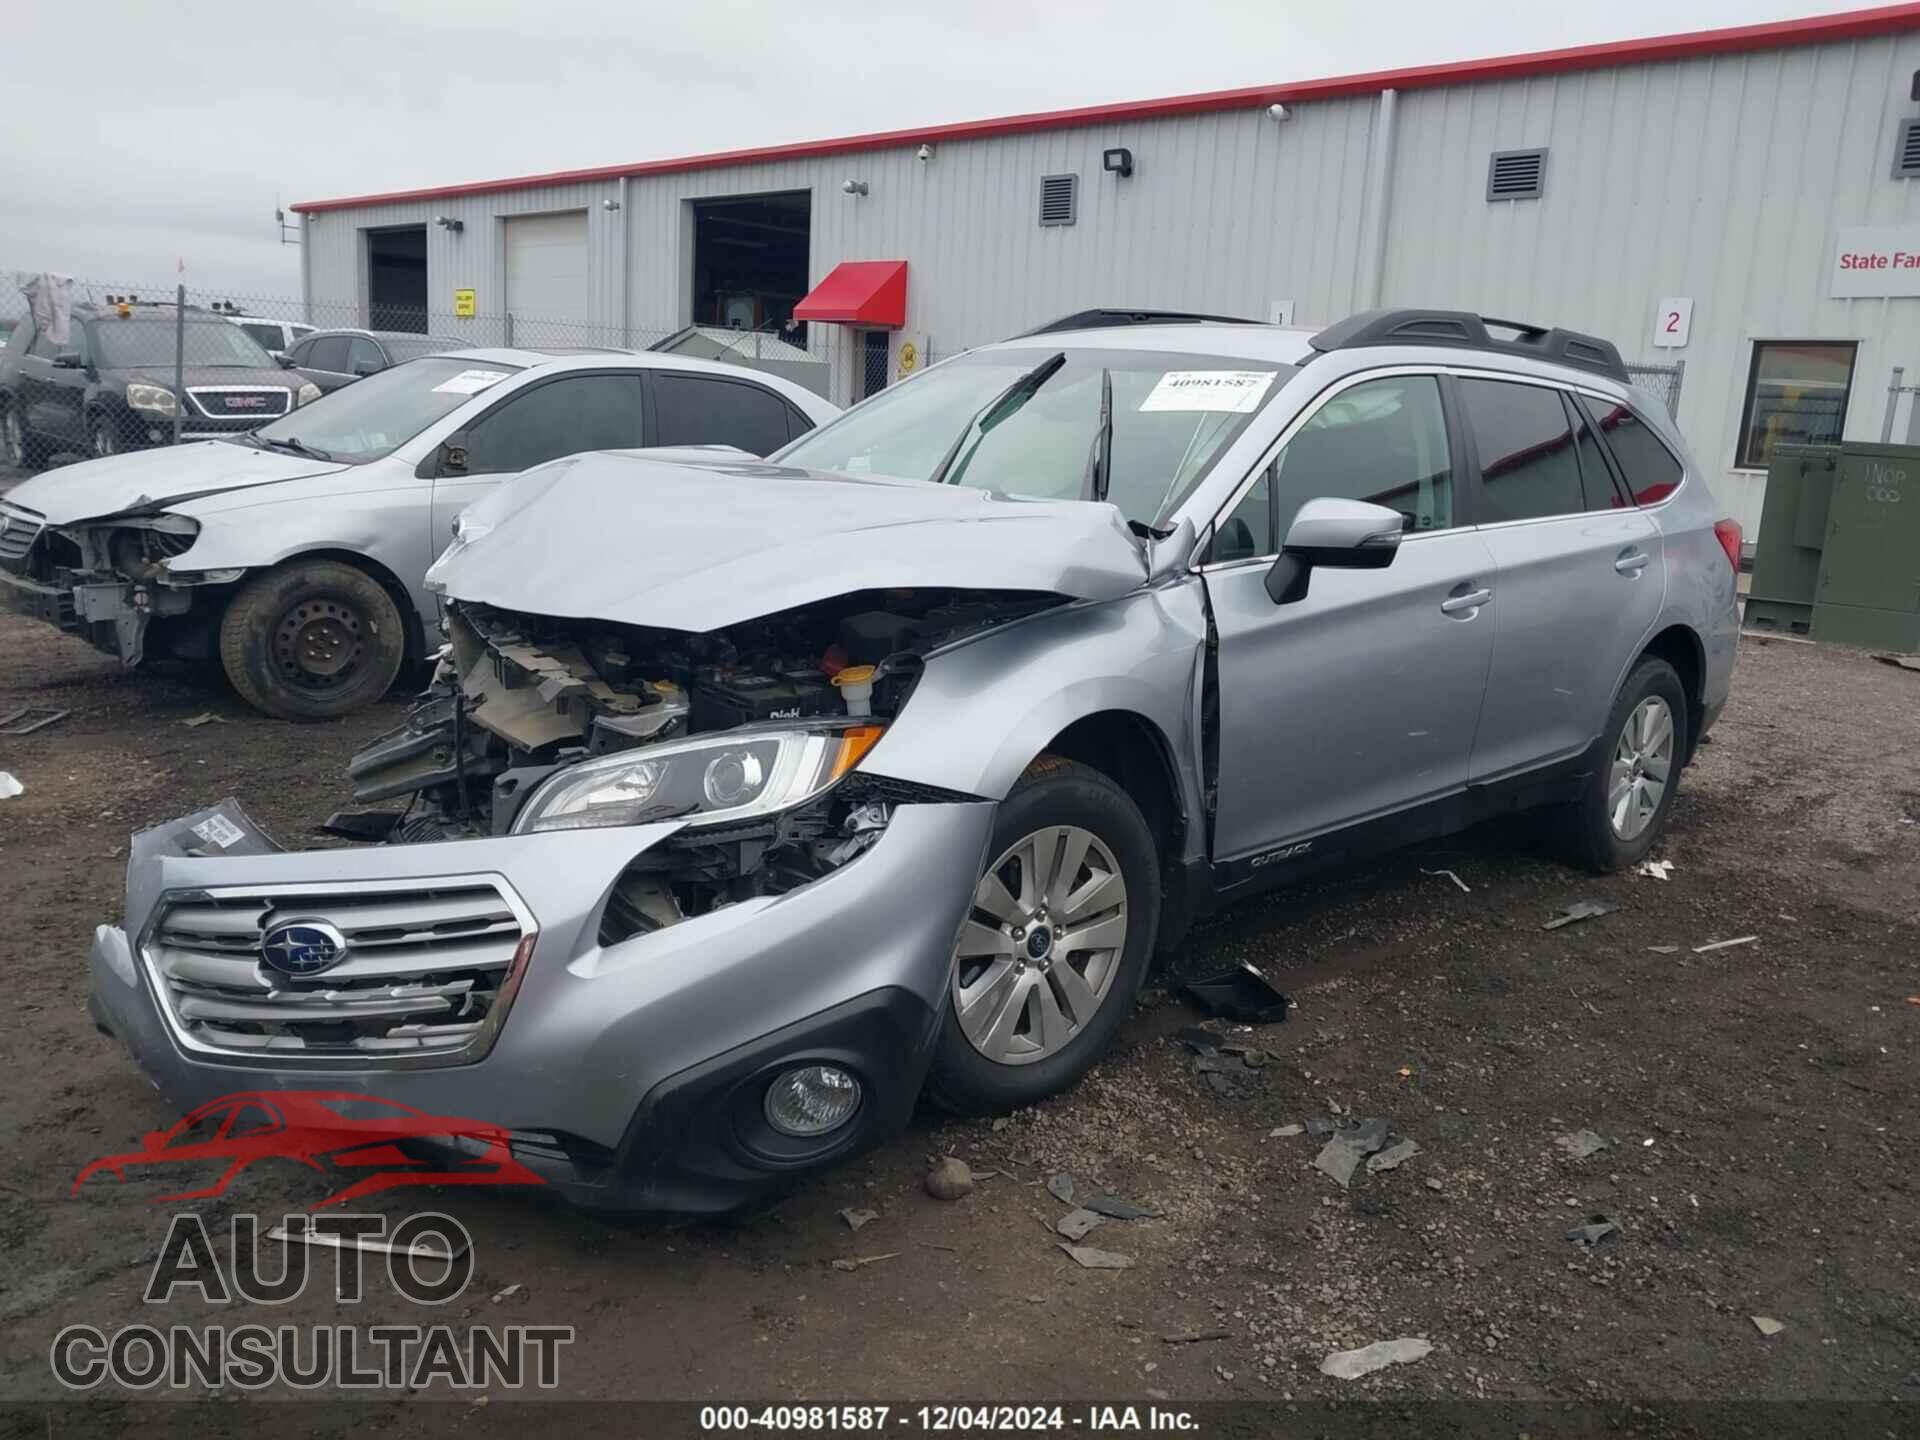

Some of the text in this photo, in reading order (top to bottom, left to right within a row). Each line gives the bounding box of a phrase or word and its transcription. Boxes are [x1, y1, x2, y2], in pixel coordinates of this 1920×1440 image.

[1840, 253, 1888, 269] State
[1667, 312, 1680, 332] 2
[225, 397, 267, 408] GMC
